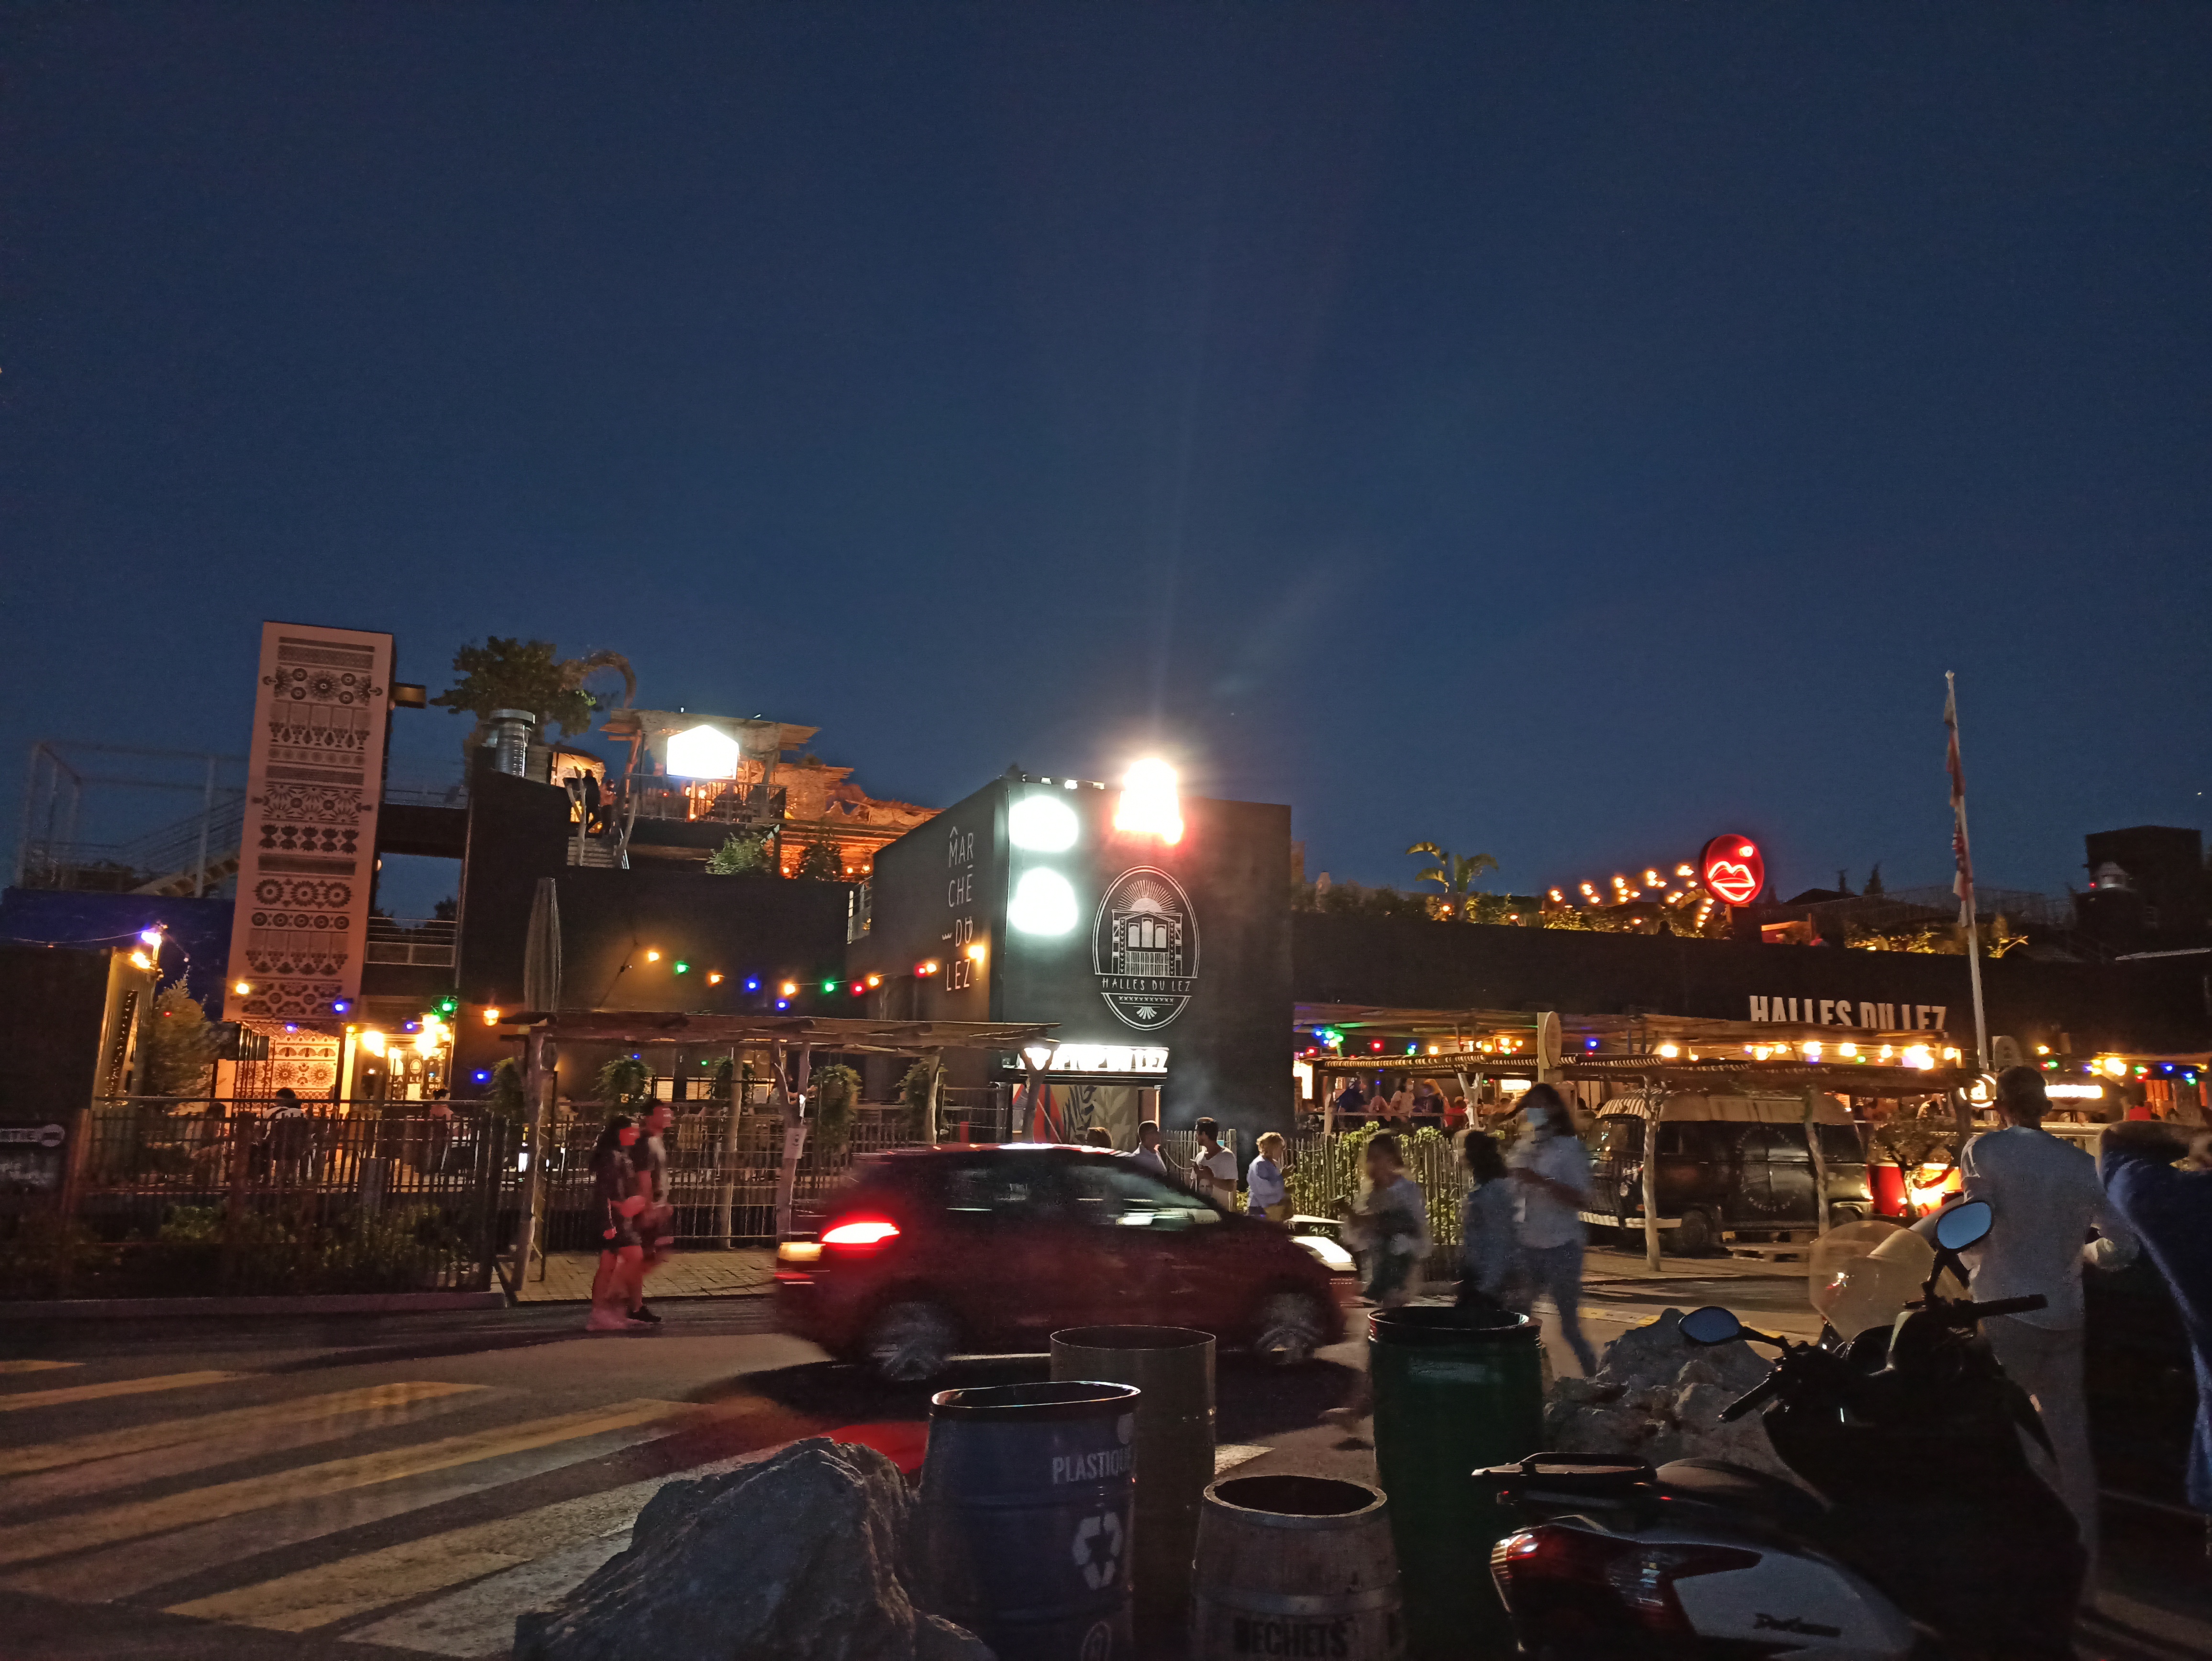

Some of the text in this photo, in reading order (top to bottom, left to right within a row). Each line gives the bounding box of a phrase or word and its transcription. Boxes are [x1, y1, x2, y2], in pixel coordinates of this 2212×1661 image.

[946, 958, 971, 991] LEZ
[1101, 977, 1191, 992] HALLES DU LEZ
[1749, 995, 1853, 1026] HALLES
